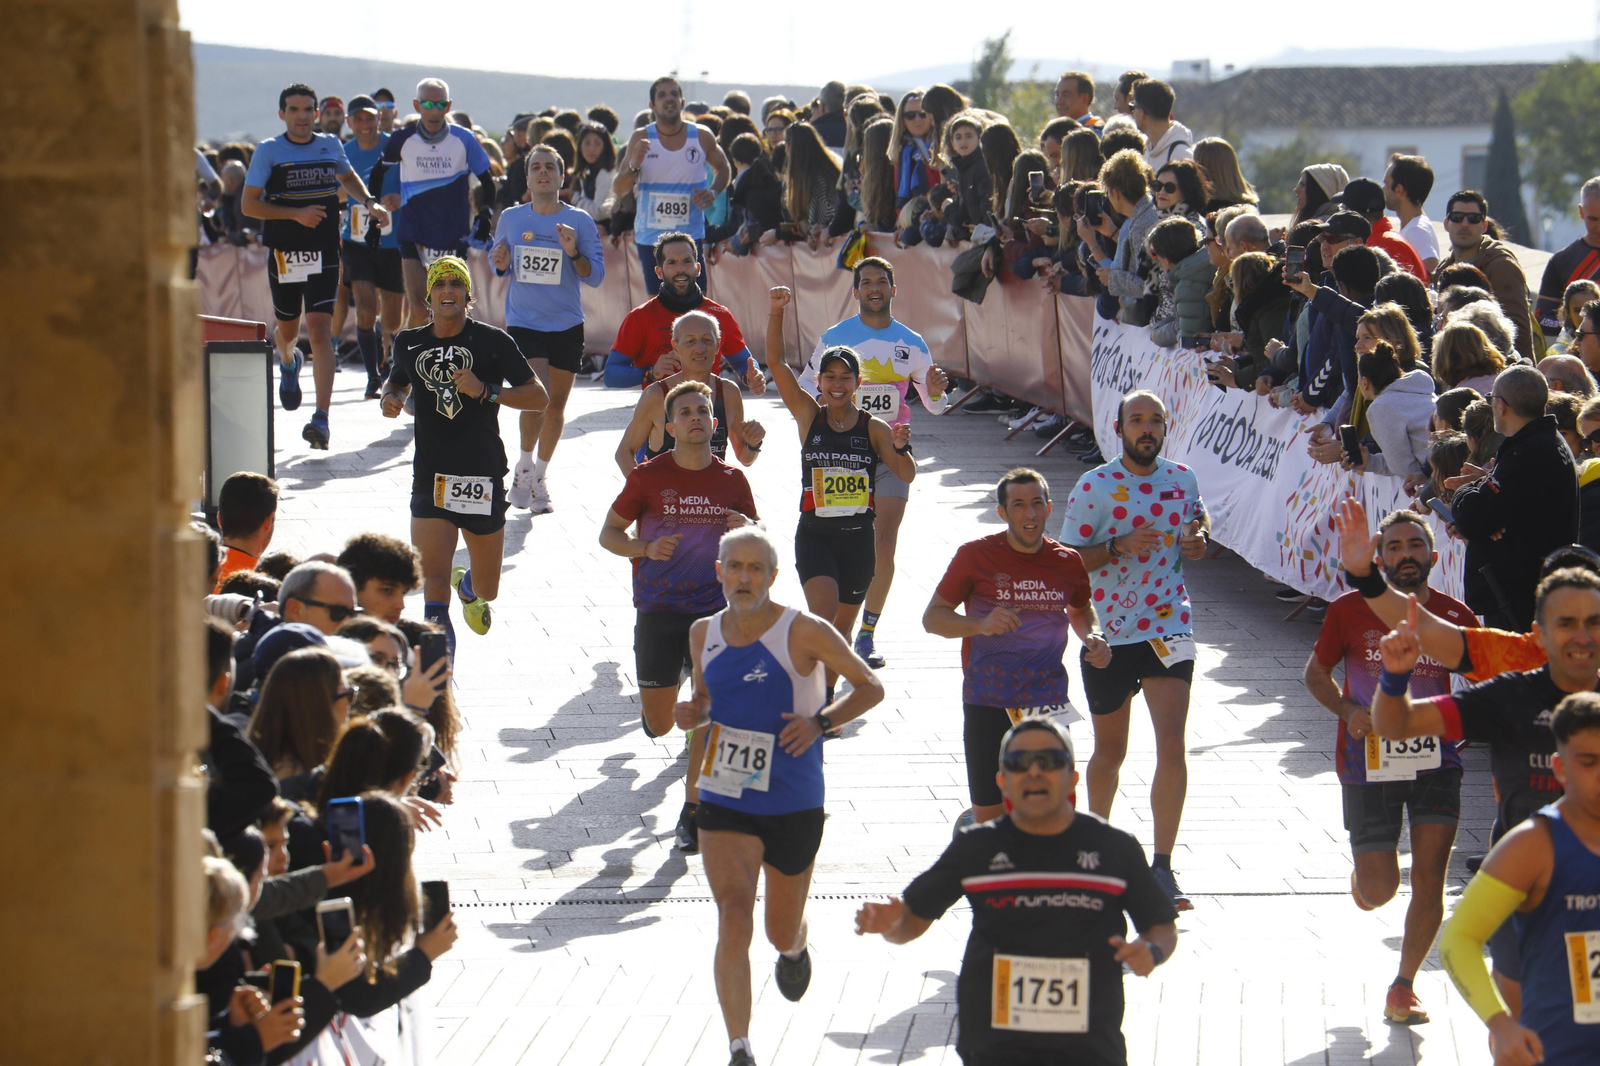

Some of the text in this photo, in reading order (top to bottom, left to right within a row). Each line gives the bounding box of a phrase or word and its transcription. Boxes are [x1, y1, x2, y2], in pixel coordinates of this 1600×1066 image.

[286, 180, 323, 189] CHALLENGE
[656, 201, 688, 216] 4893
[285, 250, 319, 264] 2150
[522, 255, 560, 273] 3527
[434, 346, 454, 363] 34
[861, 394, 891, 411] 548
[805, 452, 872, 465] SAN PABLO
[451, 482, 484, 500] 549
[824, 476, 867, 494] 2084
[679, 496, 711, 505] MEDIA
[663, 503, 728, 516] 36 MARATÓN
[1013, 580, 1047, 591] MEDIA
[996, 588, 1065, 602] 36 MARATÓN
[1365, 649, 1382, 662] 36
[1381, 736, 1437, 755] 1334
[718, 740, 766, 771] 1718
[1012, 976, 1079, 1007] 1751
